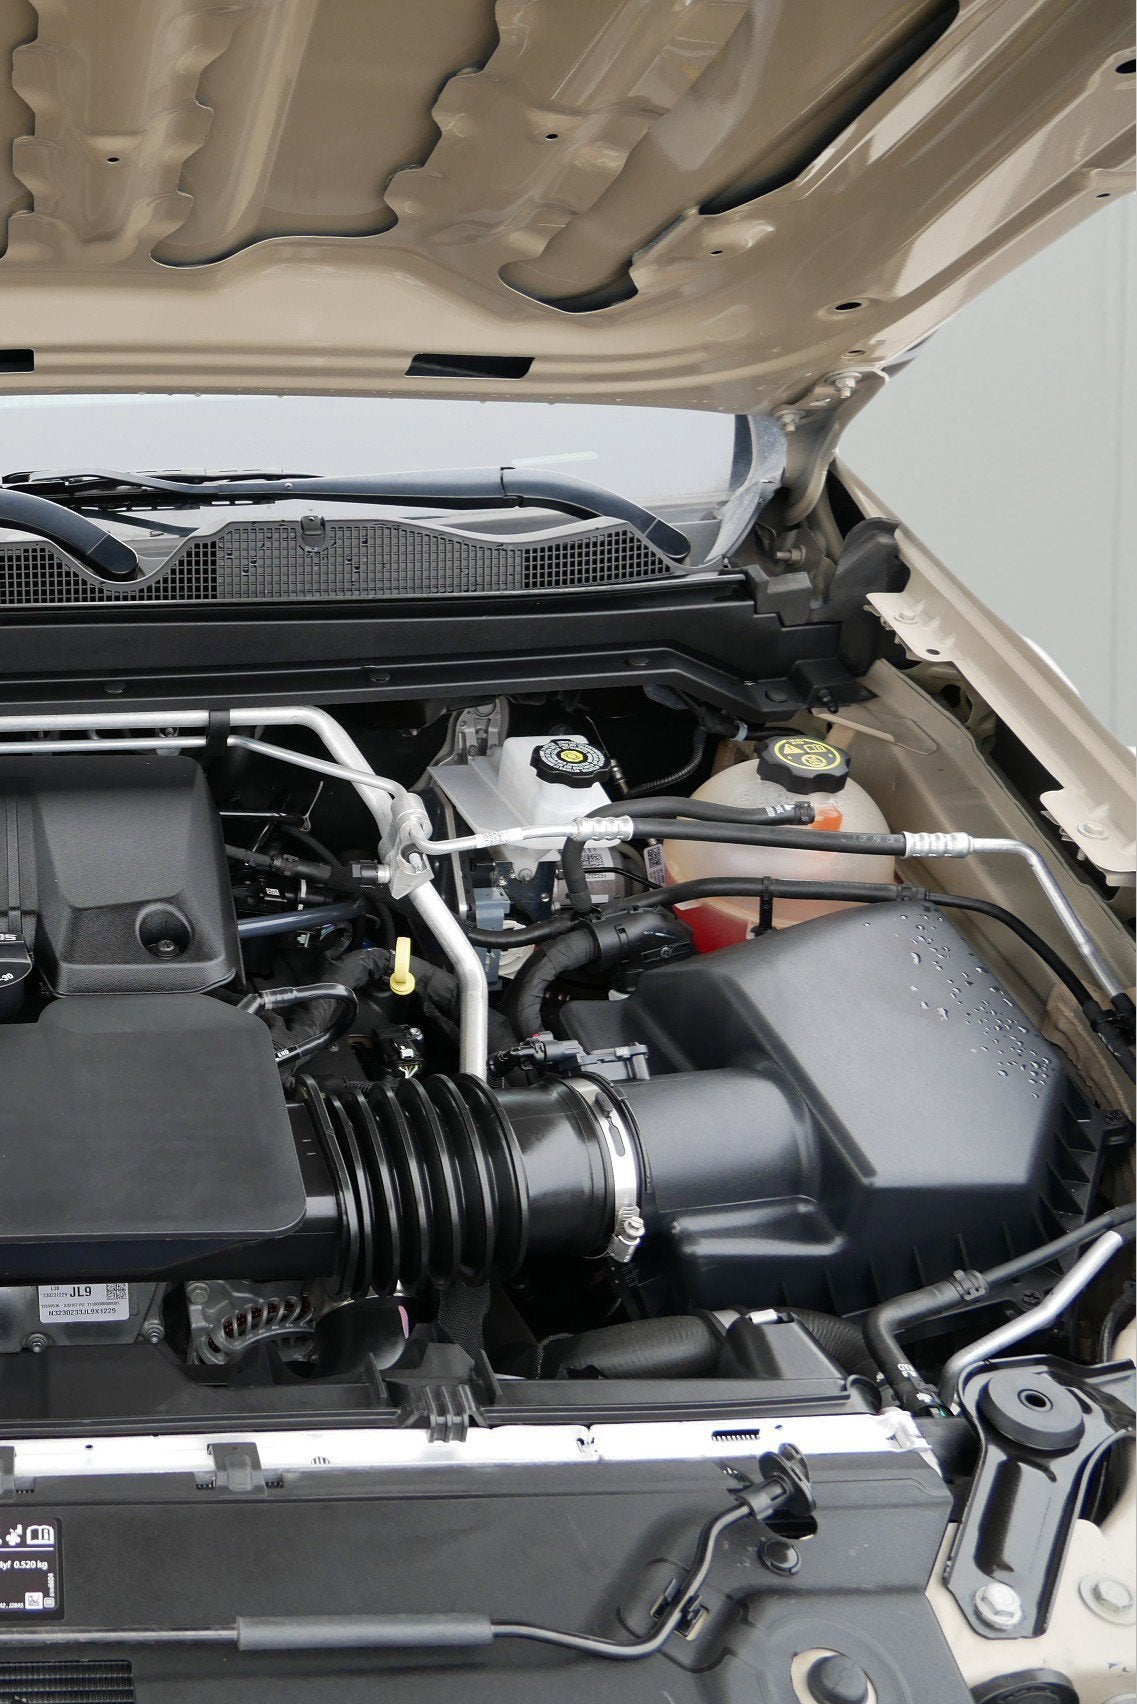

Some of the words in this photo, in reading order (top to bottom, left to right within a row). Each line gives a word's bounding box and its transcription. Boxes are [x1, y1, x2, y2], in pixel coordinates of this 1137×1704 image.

[70, 1286, 92, 1297] JL9
[14, 1561, 36, 1569] 0.520
[36, 1560, 48, 1570] kg
